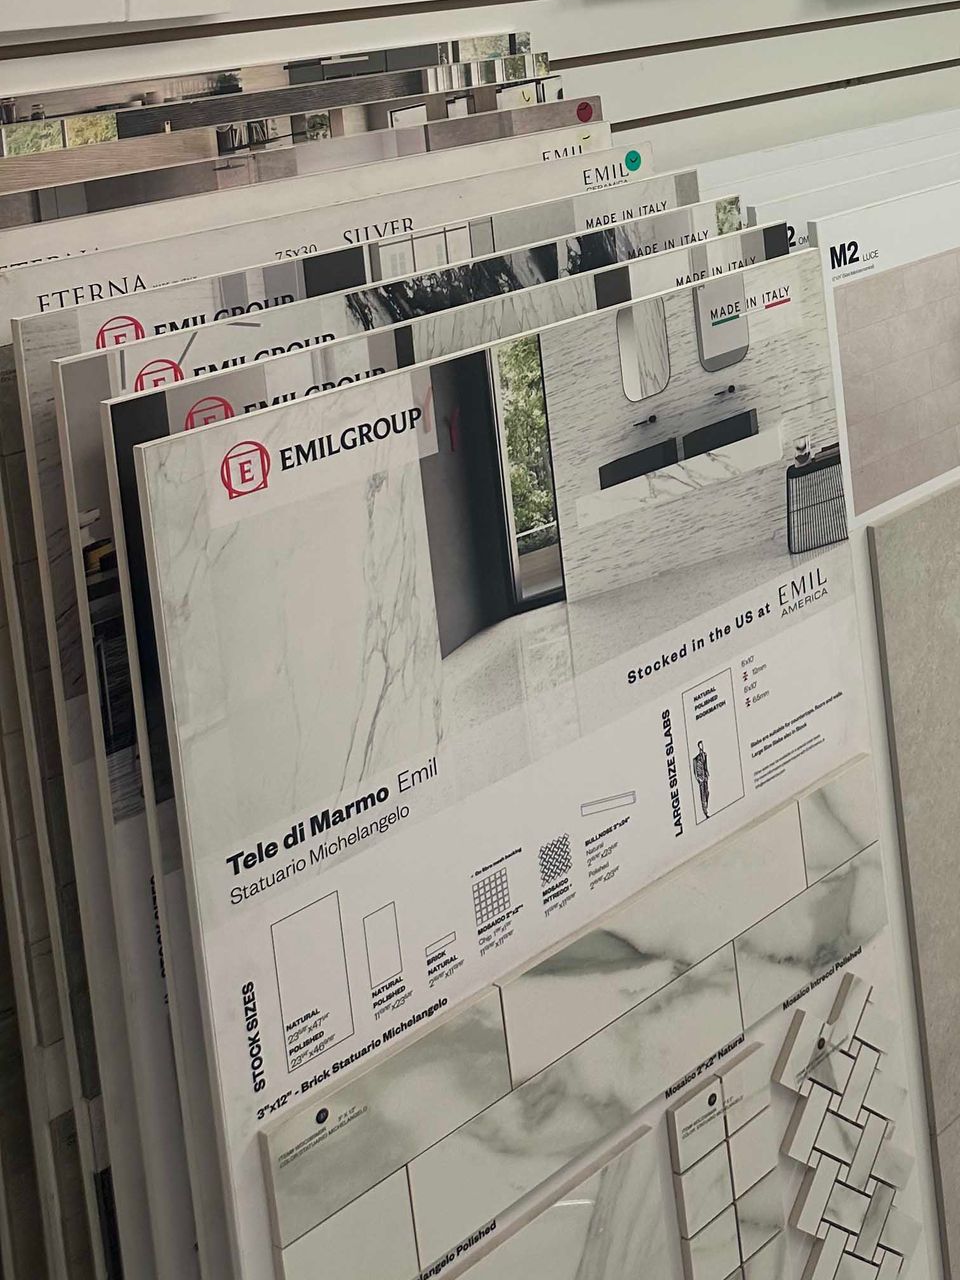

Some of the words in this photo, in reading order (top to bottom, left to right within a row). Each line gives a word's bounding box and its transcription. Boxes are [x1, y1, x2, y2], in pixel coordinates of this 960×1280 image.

[582, 162, 630, 186] EMIL
[585, 215, 617, 230] MADE
[622, 210, 634, 221] IN
[638, 200, 668, 217] ITALY
[627, 243, 659, 260] MADE
[664, 238, 675, 250] IN
[680, 229, 710, 247] ITALY
[787, 225, 797, 248] 2
[829, 240, 860, 270] M2
[862, 249, 879, 262] LUCE
[675, 270, 706, 287] MADE
[711, 264, 723, 276] IN
[727, 256, 757, 273] ITALY
[710, 301, 741, 321] MADE
[745, 295, 758, 309] IN
[762, 285, 791, 304] ITALY
[279, 407, 423, 471] EMILGROUP
[777, 567, 828, 606] EMIL
[780, 587, 829, 619] AMERICA
[627, 644, 688, 685] Stocked
[691, 638, 705, 653] in
[708, 624, 731, 644] the
[735, 610, 754, 630] US
[757, 602, 771, 619] at
[693, 686, 717, 703] NATURAL
[694, 694, 719, 712] POLISHED
[695, 700, 727, 721] BOOKMATCH
[661, 709, 675, 756] SLABS
[666, 758, 678, 790] SIZE
[226, 841, 279, 876] Tele
[283, 821, 306, 850] di
[309, 786, 390, 837] Marmo
[397, 756, 438, 794] Emil
[670, 792, 684, 838] LARGE
[584, 826, 613, 847] BULLNOSE
[230, 856, 306, 906] Statuario
[309, 804, 410, 866] Michelangelo
[542, 877, 569, 897] MOSAICO
[477, 915, 506, 936] MOSAICO
[426, 950, 447, 966] BRICK
[427, 954, 459, 976] NATURAL
[371, 976, 404, 998] NATURAL
[781, 986, 811, 1012] Mosaico
[809, 966, 835, 991] Intrecci
[834, 945, 862, 972] Polished
[241, 980, 259, 1030] SIZES
[373, 985, 406, 1009] POLISHED
[286, 1008, 321, 1032] NATURAL
[257, 1089, 293, 1120] 3"x12"
[300, 1069, 331, 1094] Brick
[331, 1038, 382, 1074] Statuario
[382, 996, 448, 1044] Michelangelo
[289, 1030, 325, 1056] POLISHED
[246, 1031, 266, 1094] STOCK
[664, 1072, 697, 1100] Mosaico
[717, 1032, 745, 1060] Natural
[456, 1219, 497, 1257] Polished
